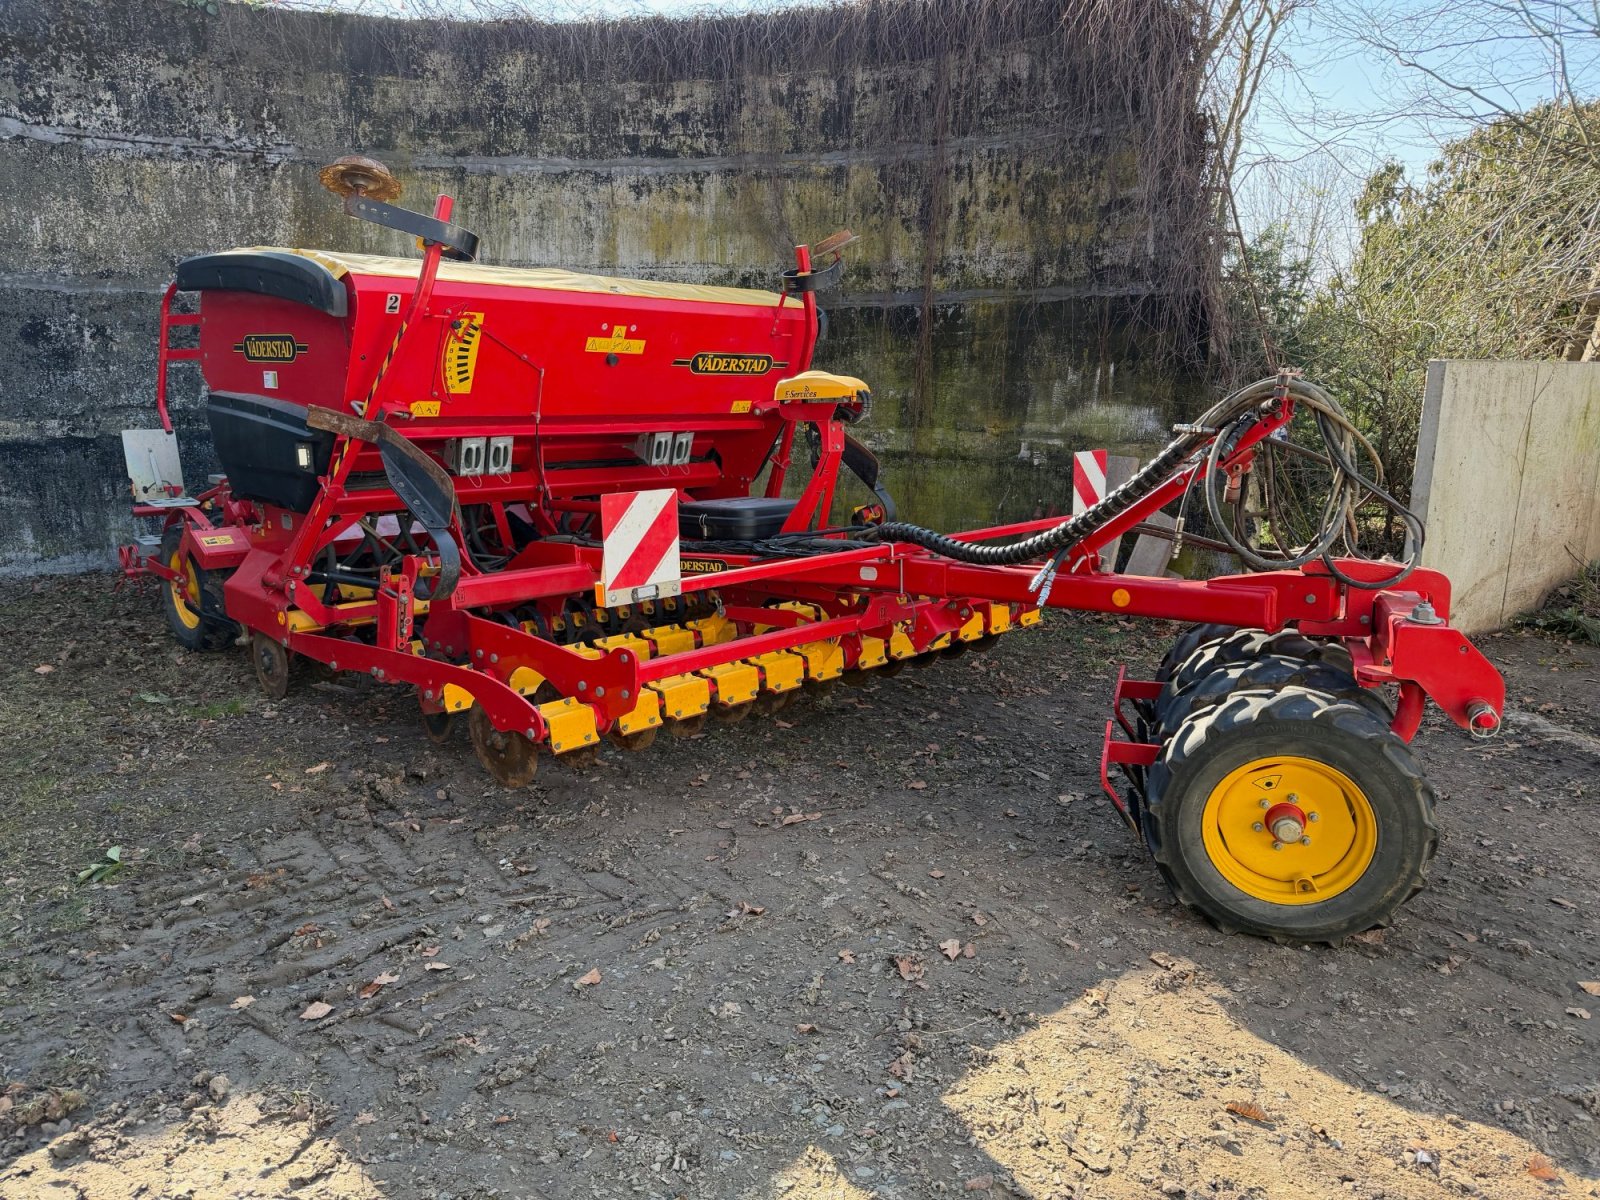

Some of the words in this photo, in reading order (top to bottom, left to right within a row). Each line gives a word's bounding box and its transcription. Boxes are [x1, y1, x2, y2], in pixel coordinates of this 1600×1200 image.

[388, 295, 399, 310] 2
[246, 337, 293, 358] VÄDERSTAD
[697, 355, 768, 372] VÄDERSTAD
[680, 560, 721, 572] DERSTAD
